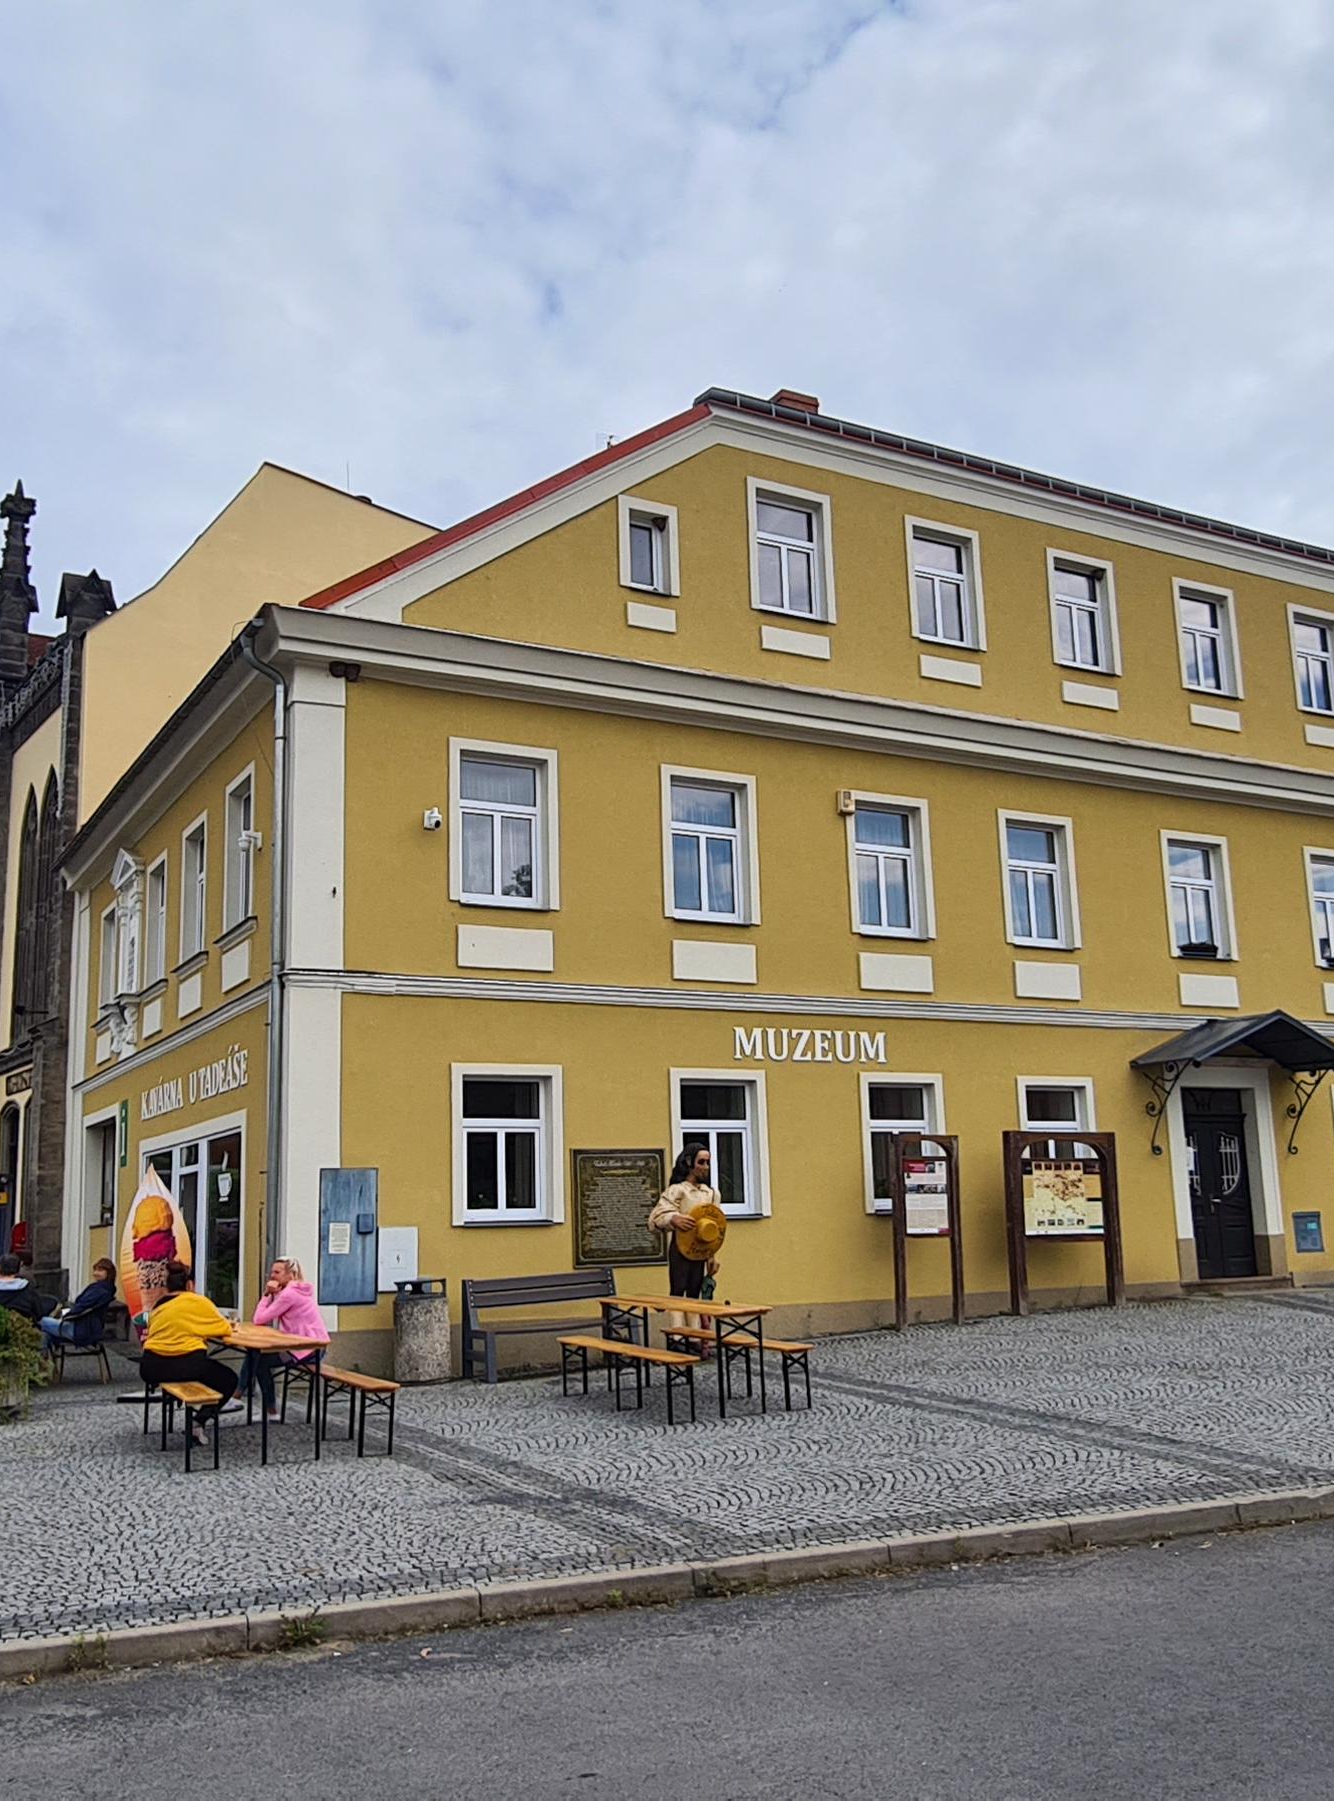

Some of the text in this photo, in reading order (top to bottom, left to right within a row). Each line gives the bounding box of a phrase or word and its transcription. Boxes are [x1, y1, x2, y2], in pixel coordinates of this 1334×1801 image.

[732, 1026, 888, 1064] MUZEUM
[141, 1043, 249, 1121] KAVÁRNA U TADEÁŠE
